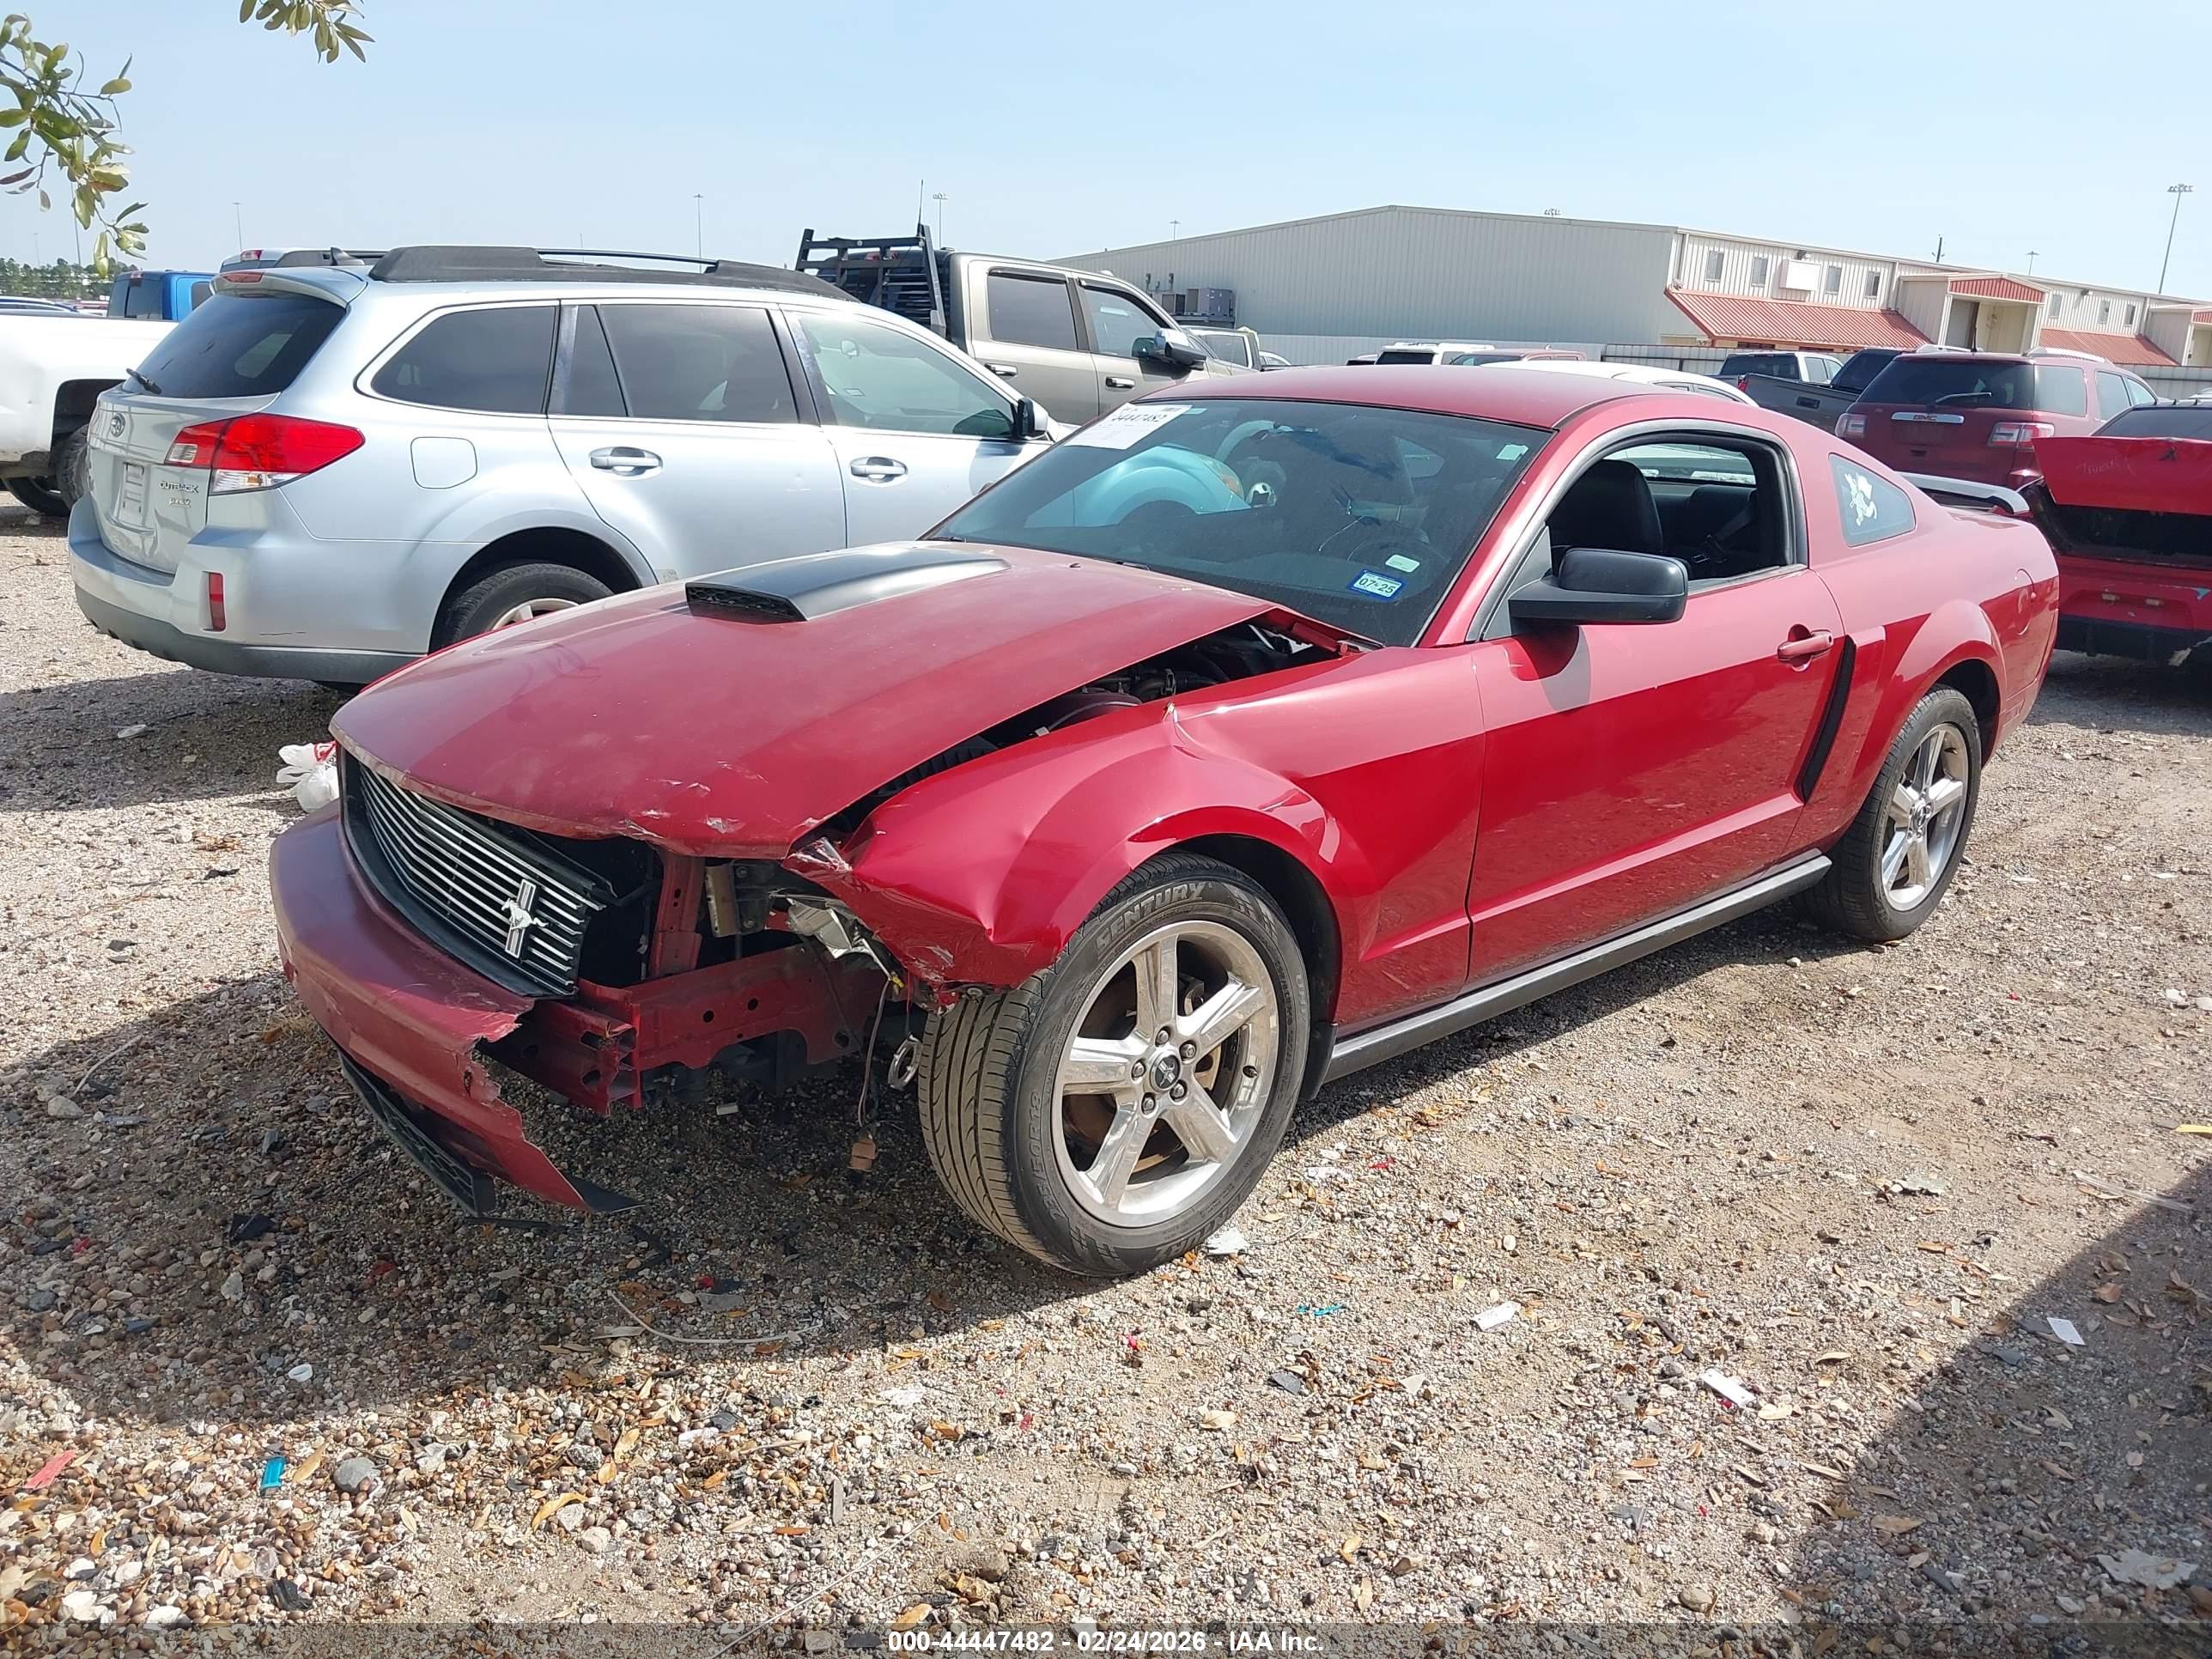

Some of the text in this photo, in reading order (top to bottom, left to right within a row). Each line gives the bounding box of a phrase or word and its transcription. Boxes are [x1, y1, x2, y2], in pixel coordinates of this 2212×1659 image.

[159, 481, 199, 494] OUTBACK
[1358, 578, 1376, 587] 07
[1377, 583, 1396, 593] 25
[1096, 881, 1206, 950] SENTURY
